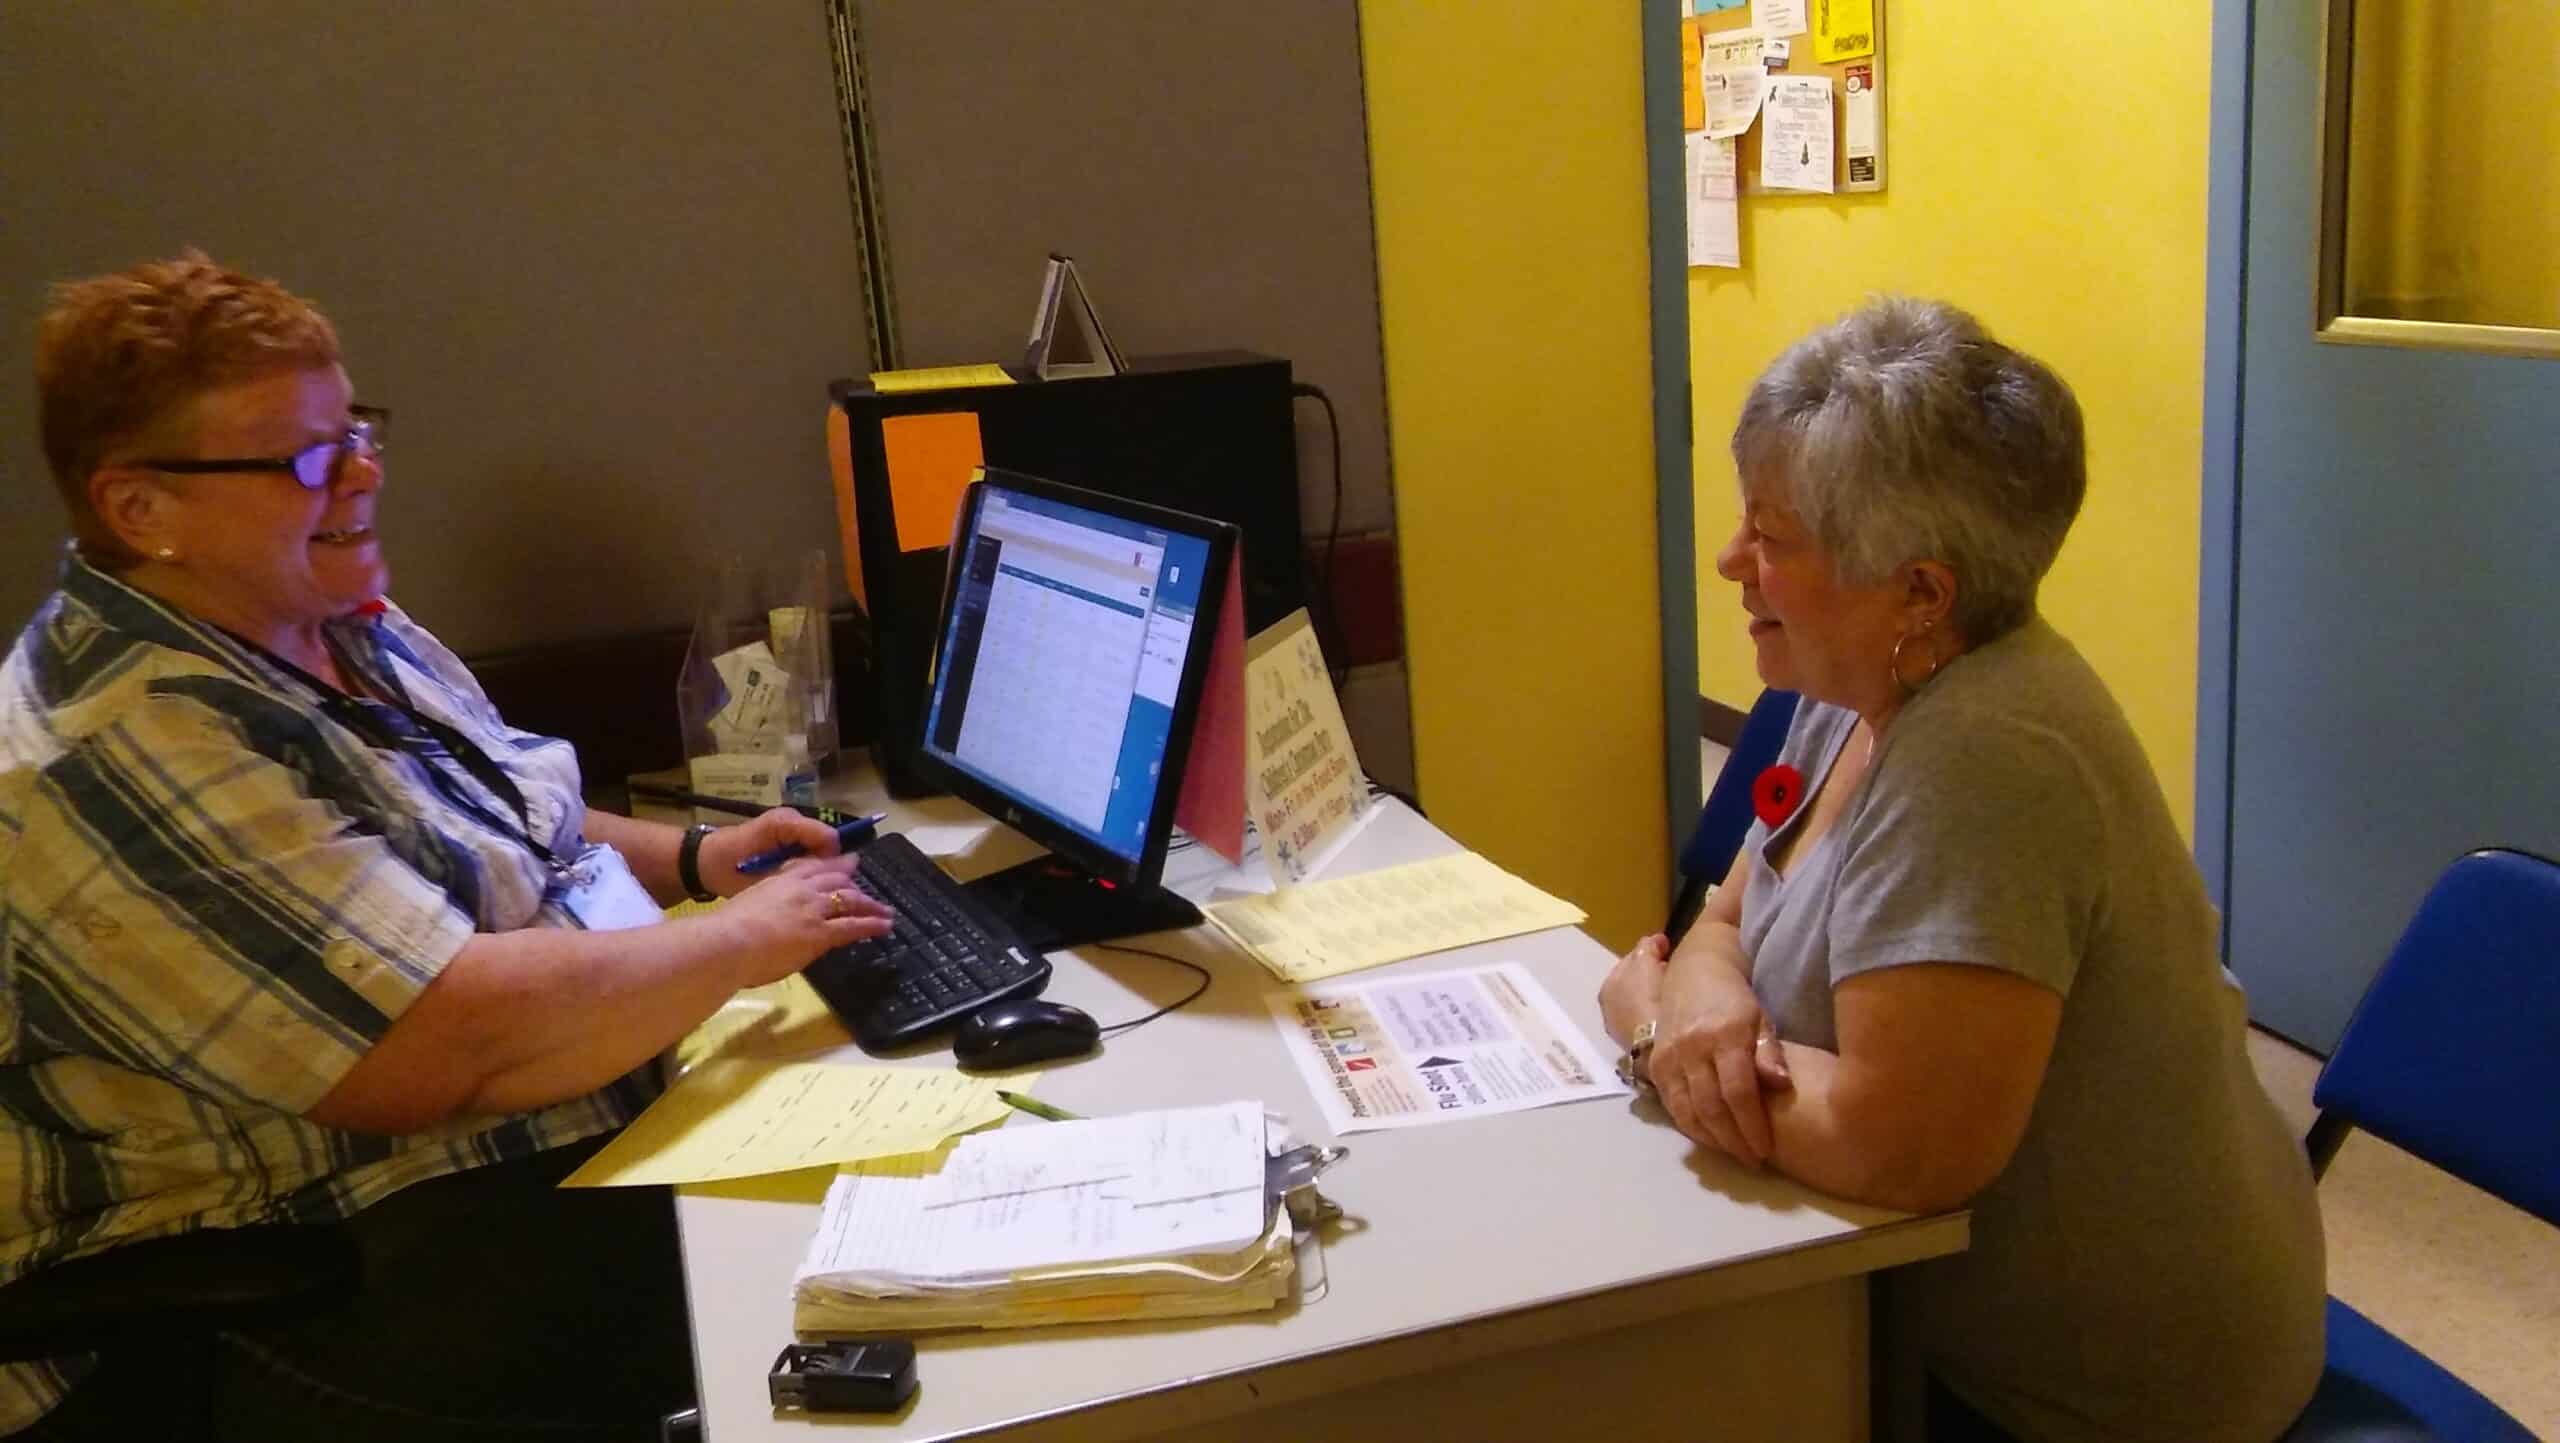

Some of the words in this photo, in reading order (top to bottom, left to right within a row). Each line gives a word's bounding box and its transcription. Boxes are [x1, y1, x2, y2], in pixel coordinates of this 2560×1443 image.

[1307, 1028, 1326, 1040] the
[1312, 1040, 1330, 1049] of
[1319, 1048, 1347, 1074] spread
[1331, 1074, 1353, 1088] the
[1417, 1068, 1452, 1092] Shot
[1338, 1087, 1371, 1119] Prevent
[1432, 1092, 1463, 1109] Flu
